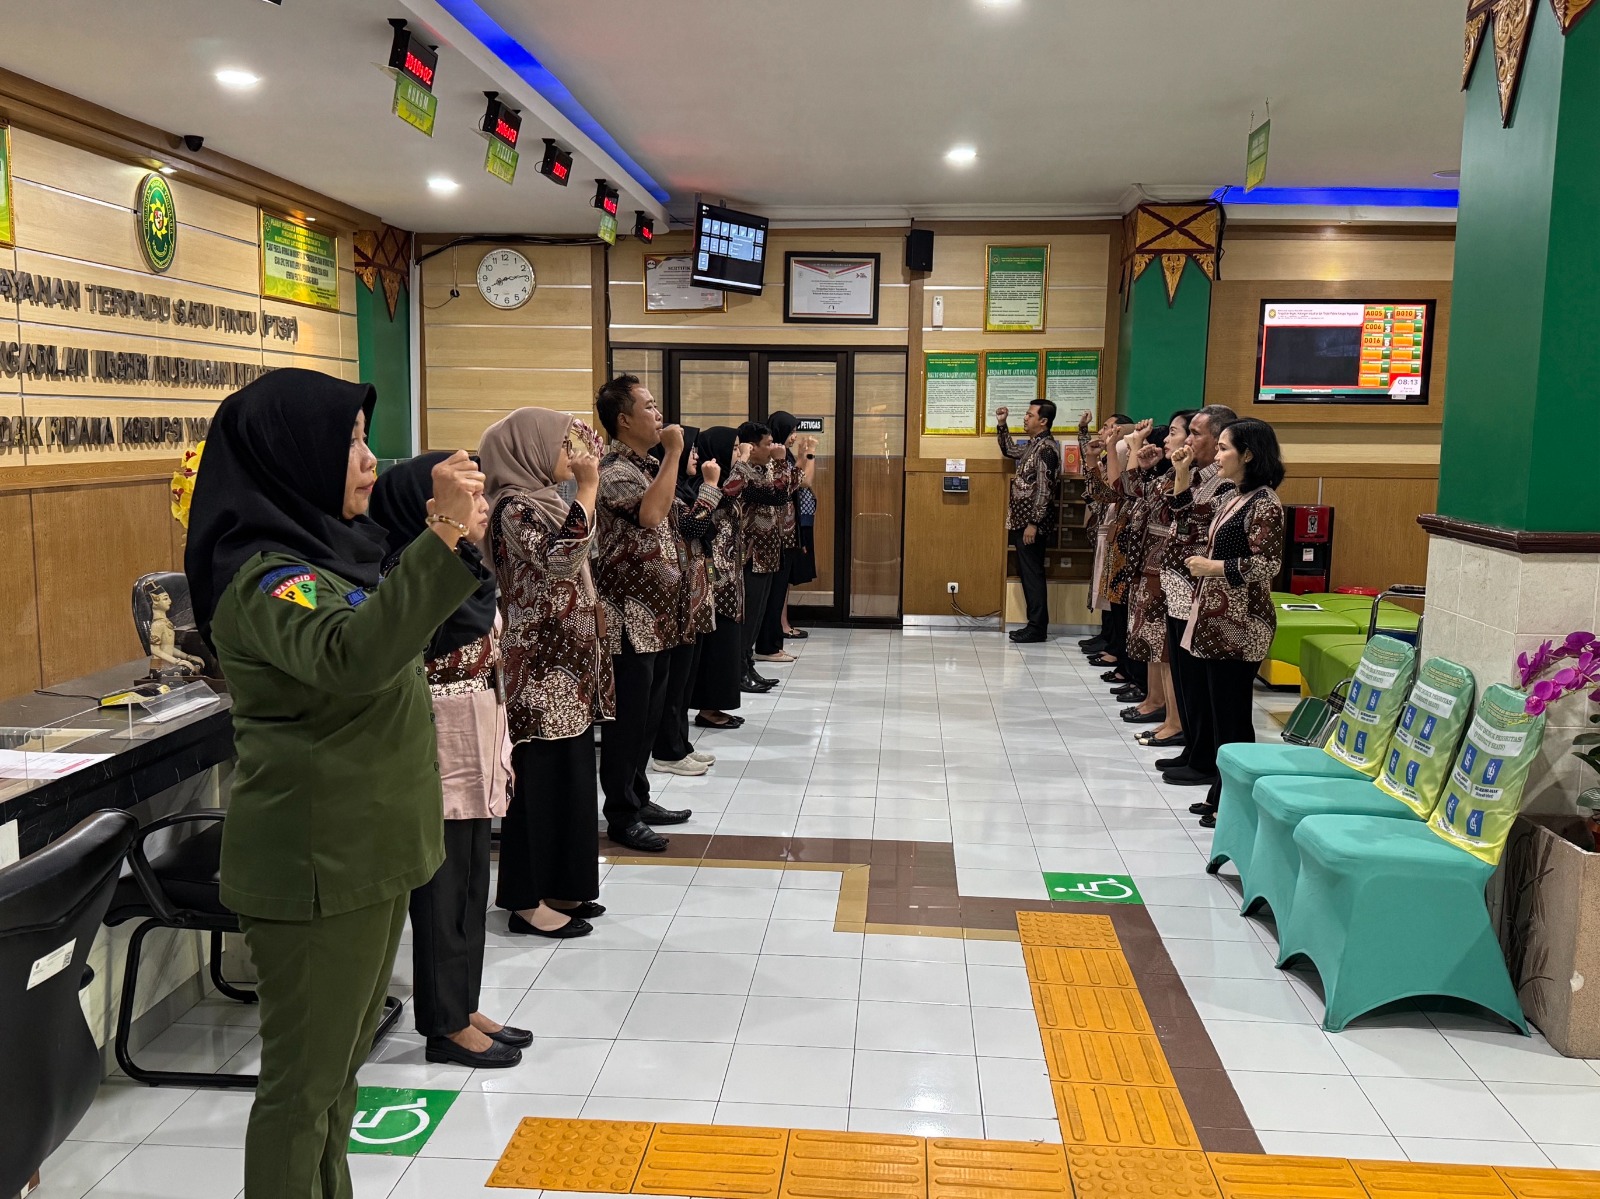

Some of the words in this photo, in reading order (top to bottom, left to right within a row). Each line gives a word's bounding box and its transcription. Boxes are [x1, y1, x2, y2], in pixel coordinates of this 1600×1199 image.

[501, 253, 509, 261] 12
[504, 296, 510, 304] 6
[85, 284, 171, 322] TERPADU
[172, 298, 213, 329] SATU
[215, 305, 257, 335] PINTU
[117, 416, 183, 443] KORUPSI
[800, 420, 821, 430] PETUGAS
[301, 583, 312, 594] S
